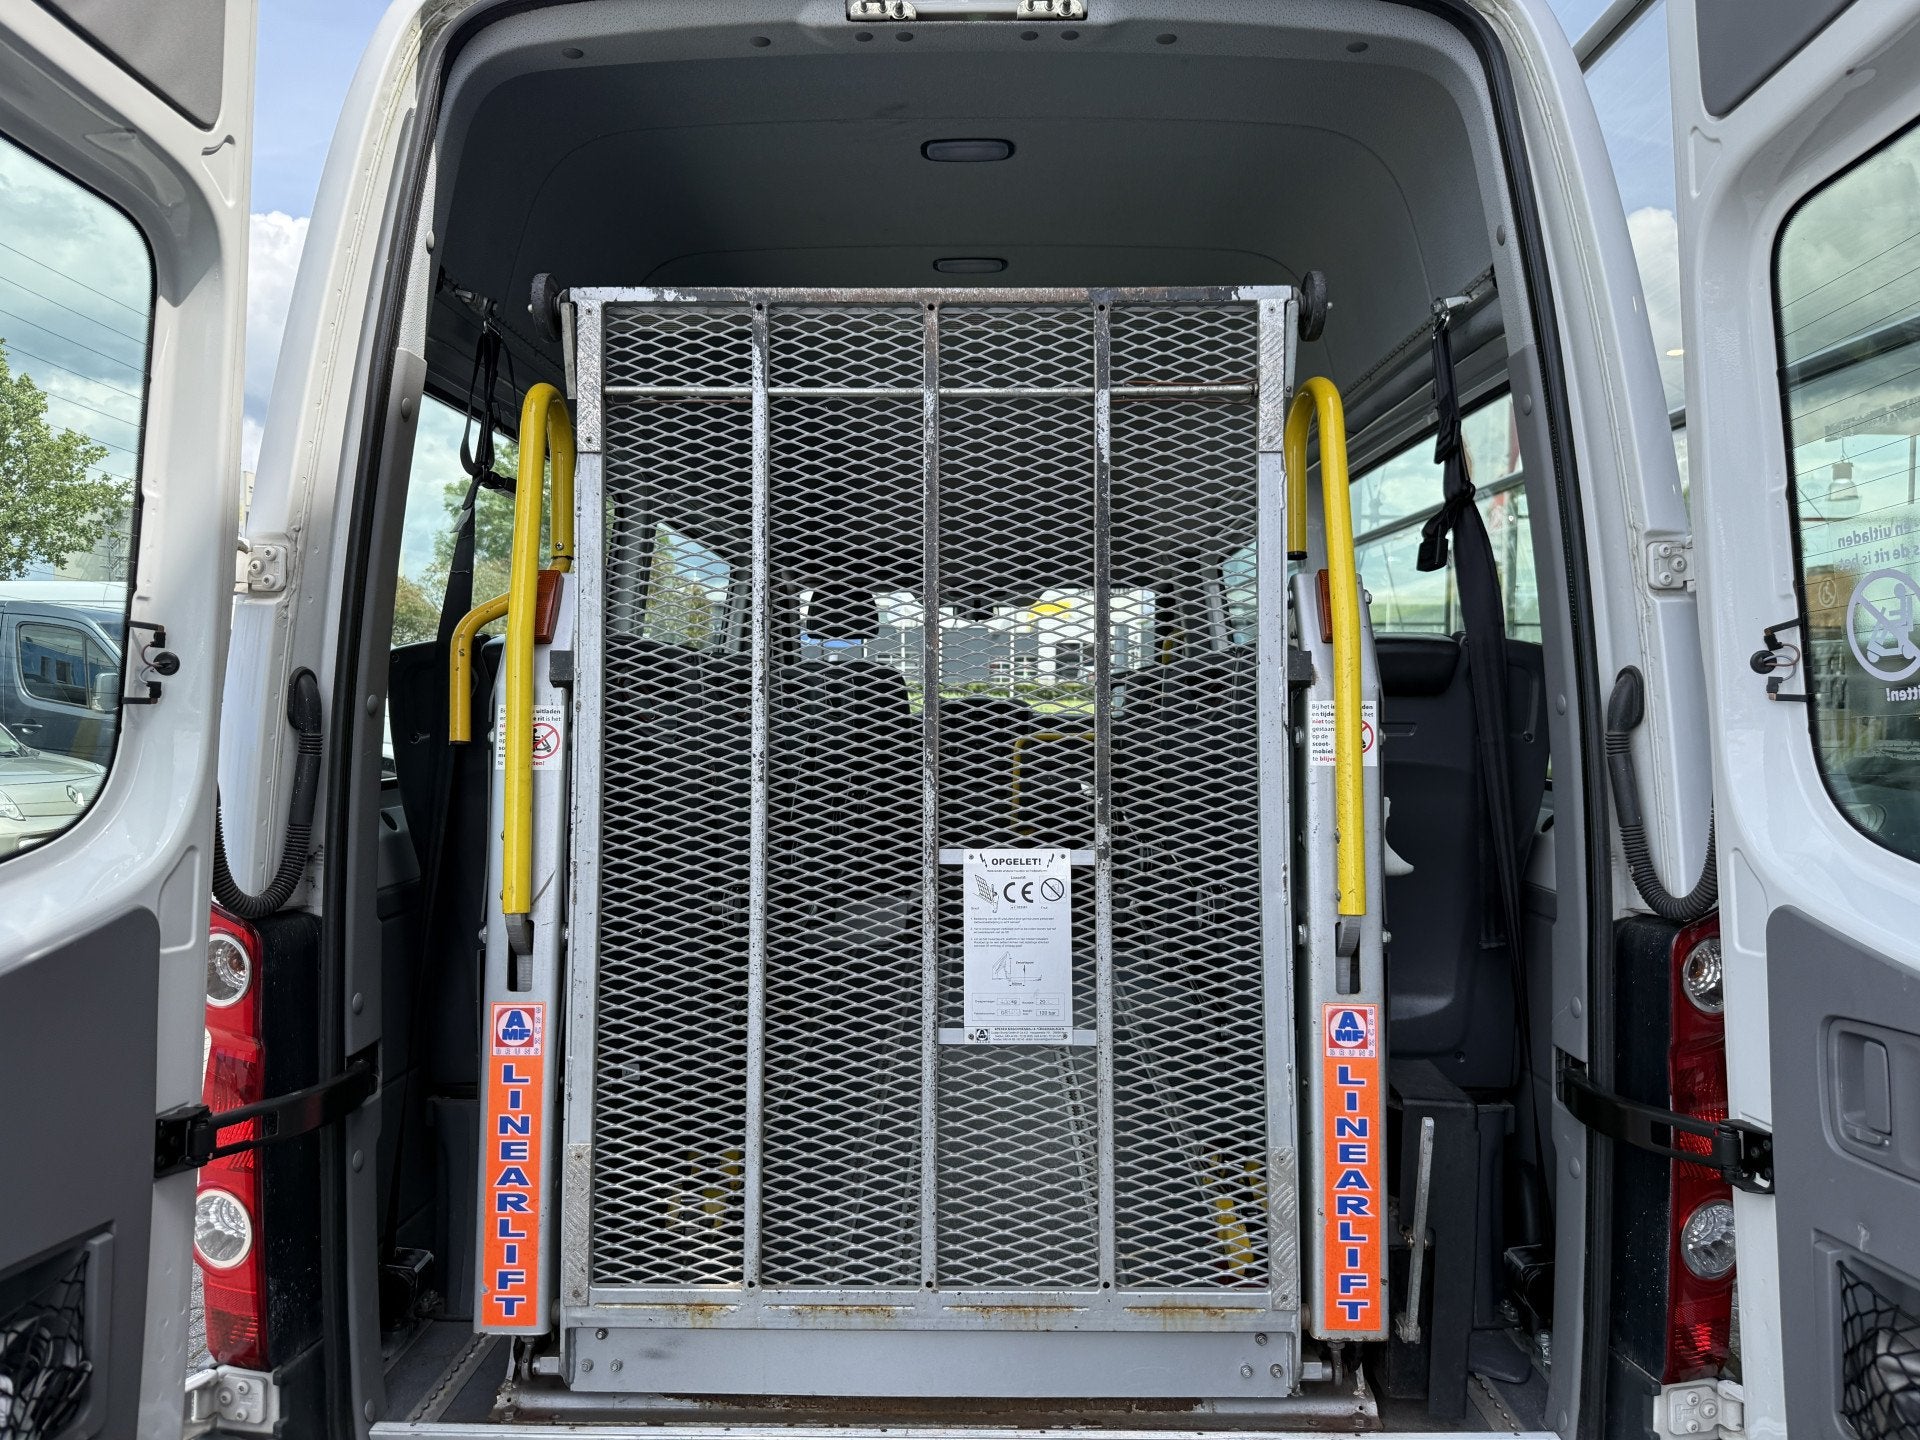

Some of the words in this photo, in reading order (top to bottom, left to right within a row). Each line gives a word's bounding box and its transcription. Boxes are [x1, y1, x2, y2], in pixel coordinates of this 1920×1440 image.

[991, 858, 1042, 866] OPGELET!
[1003, 881, 1034, 904] CE
[494, 1063, 535, 1318] LINEARLIFT
[1333, 1064, 1376, 1322] LINEARLIFT
